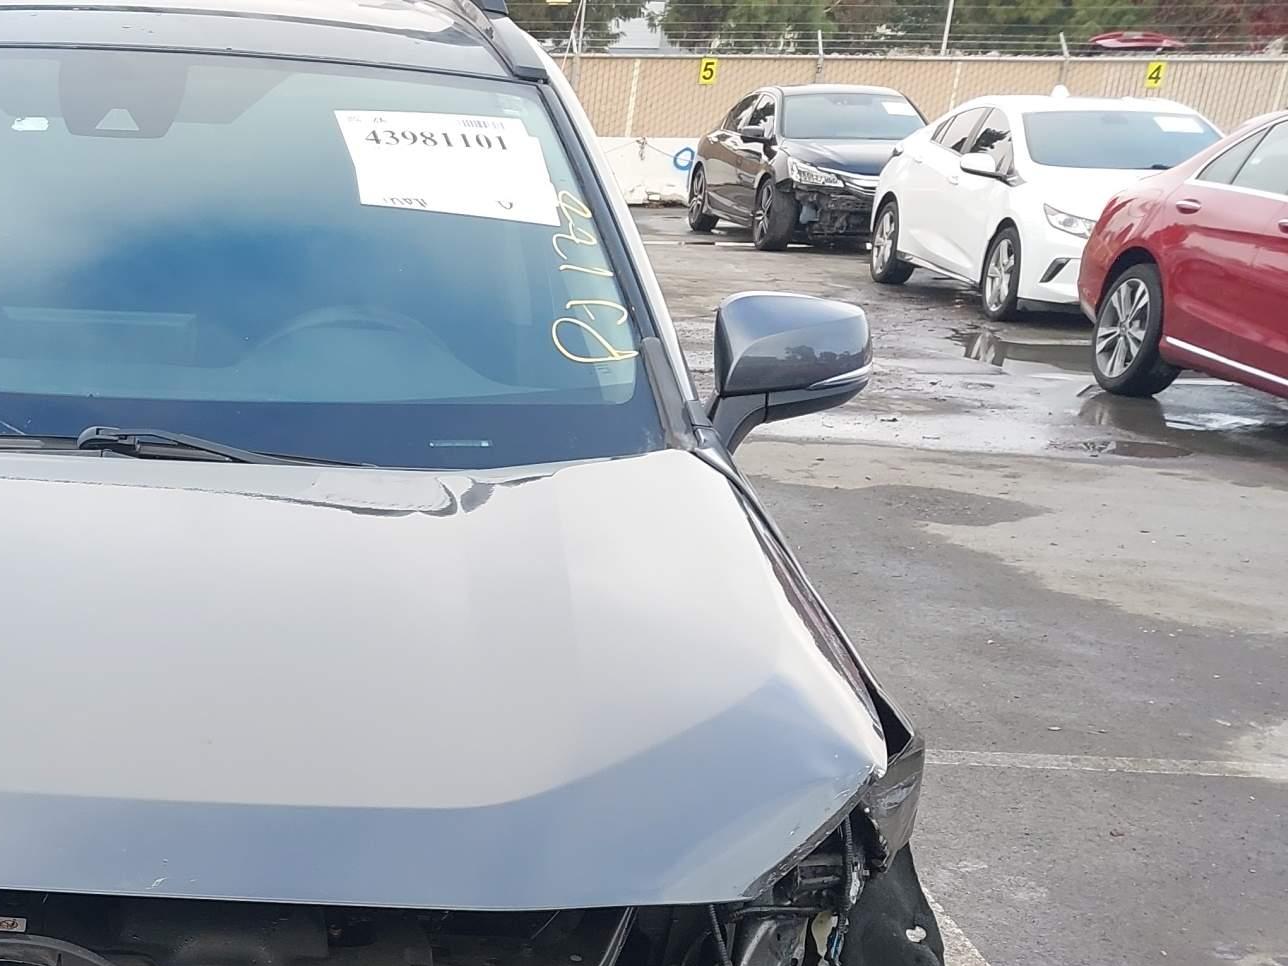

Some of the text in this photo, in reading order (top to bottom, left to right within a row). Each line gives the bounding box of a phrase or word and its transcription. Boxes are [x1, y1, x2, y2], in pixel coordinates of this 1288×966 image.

[702, 62, 715, 80] 5
[1148, 64, 1162, 84] 4
[364, 129, 508, 150] 43981101
